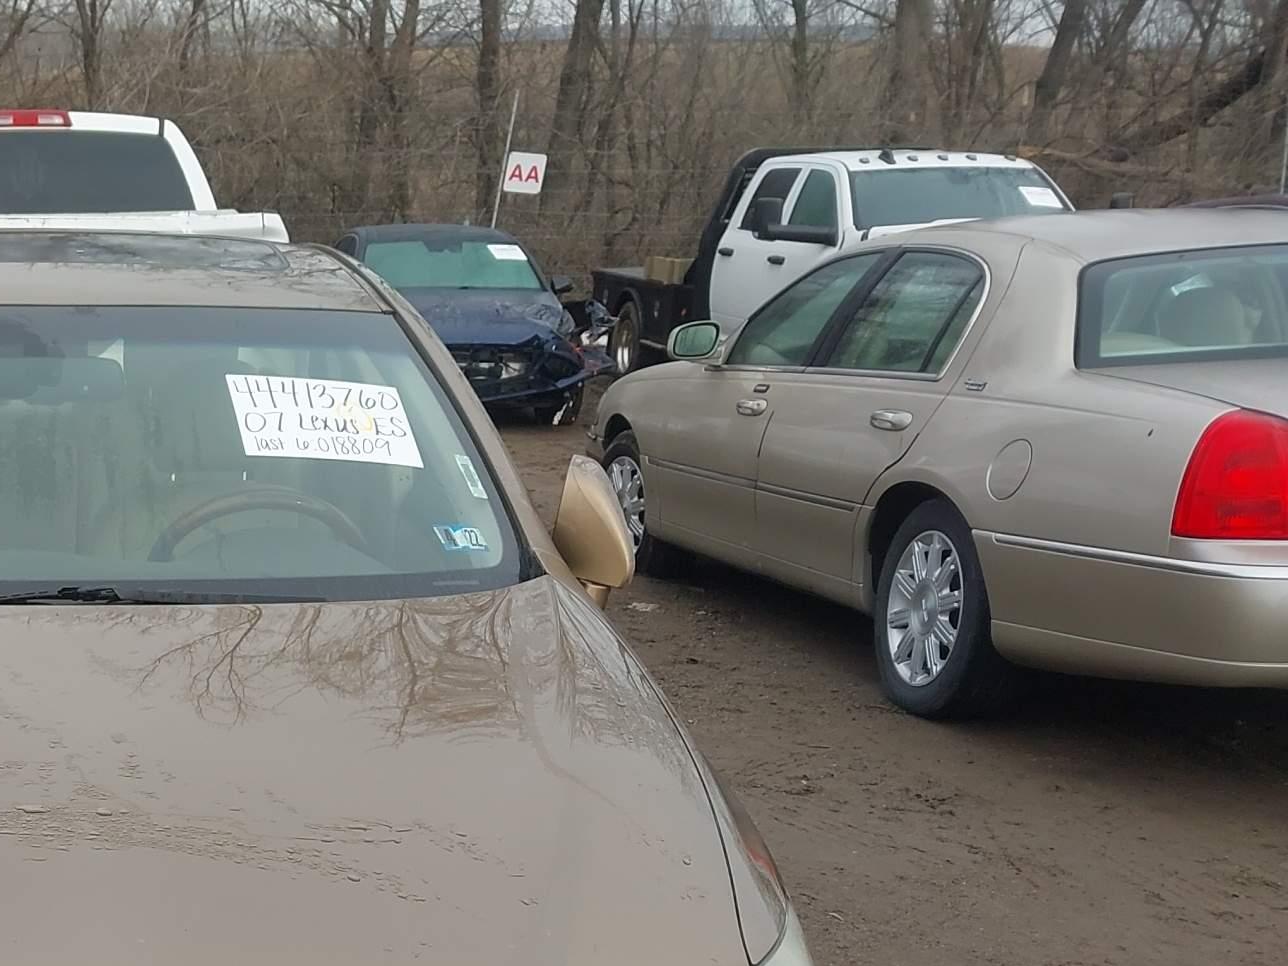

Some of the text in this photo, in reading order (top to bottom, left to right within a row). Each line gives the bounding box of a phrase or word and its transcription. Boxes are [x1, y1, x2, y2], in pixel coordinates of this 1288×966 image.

[508, 163, 539, 183] AA
[232, 376, 399, 410] 44413760
[244, 411, 408, 438] 07 Lexus ES
[253, 435, 285, 452] last
